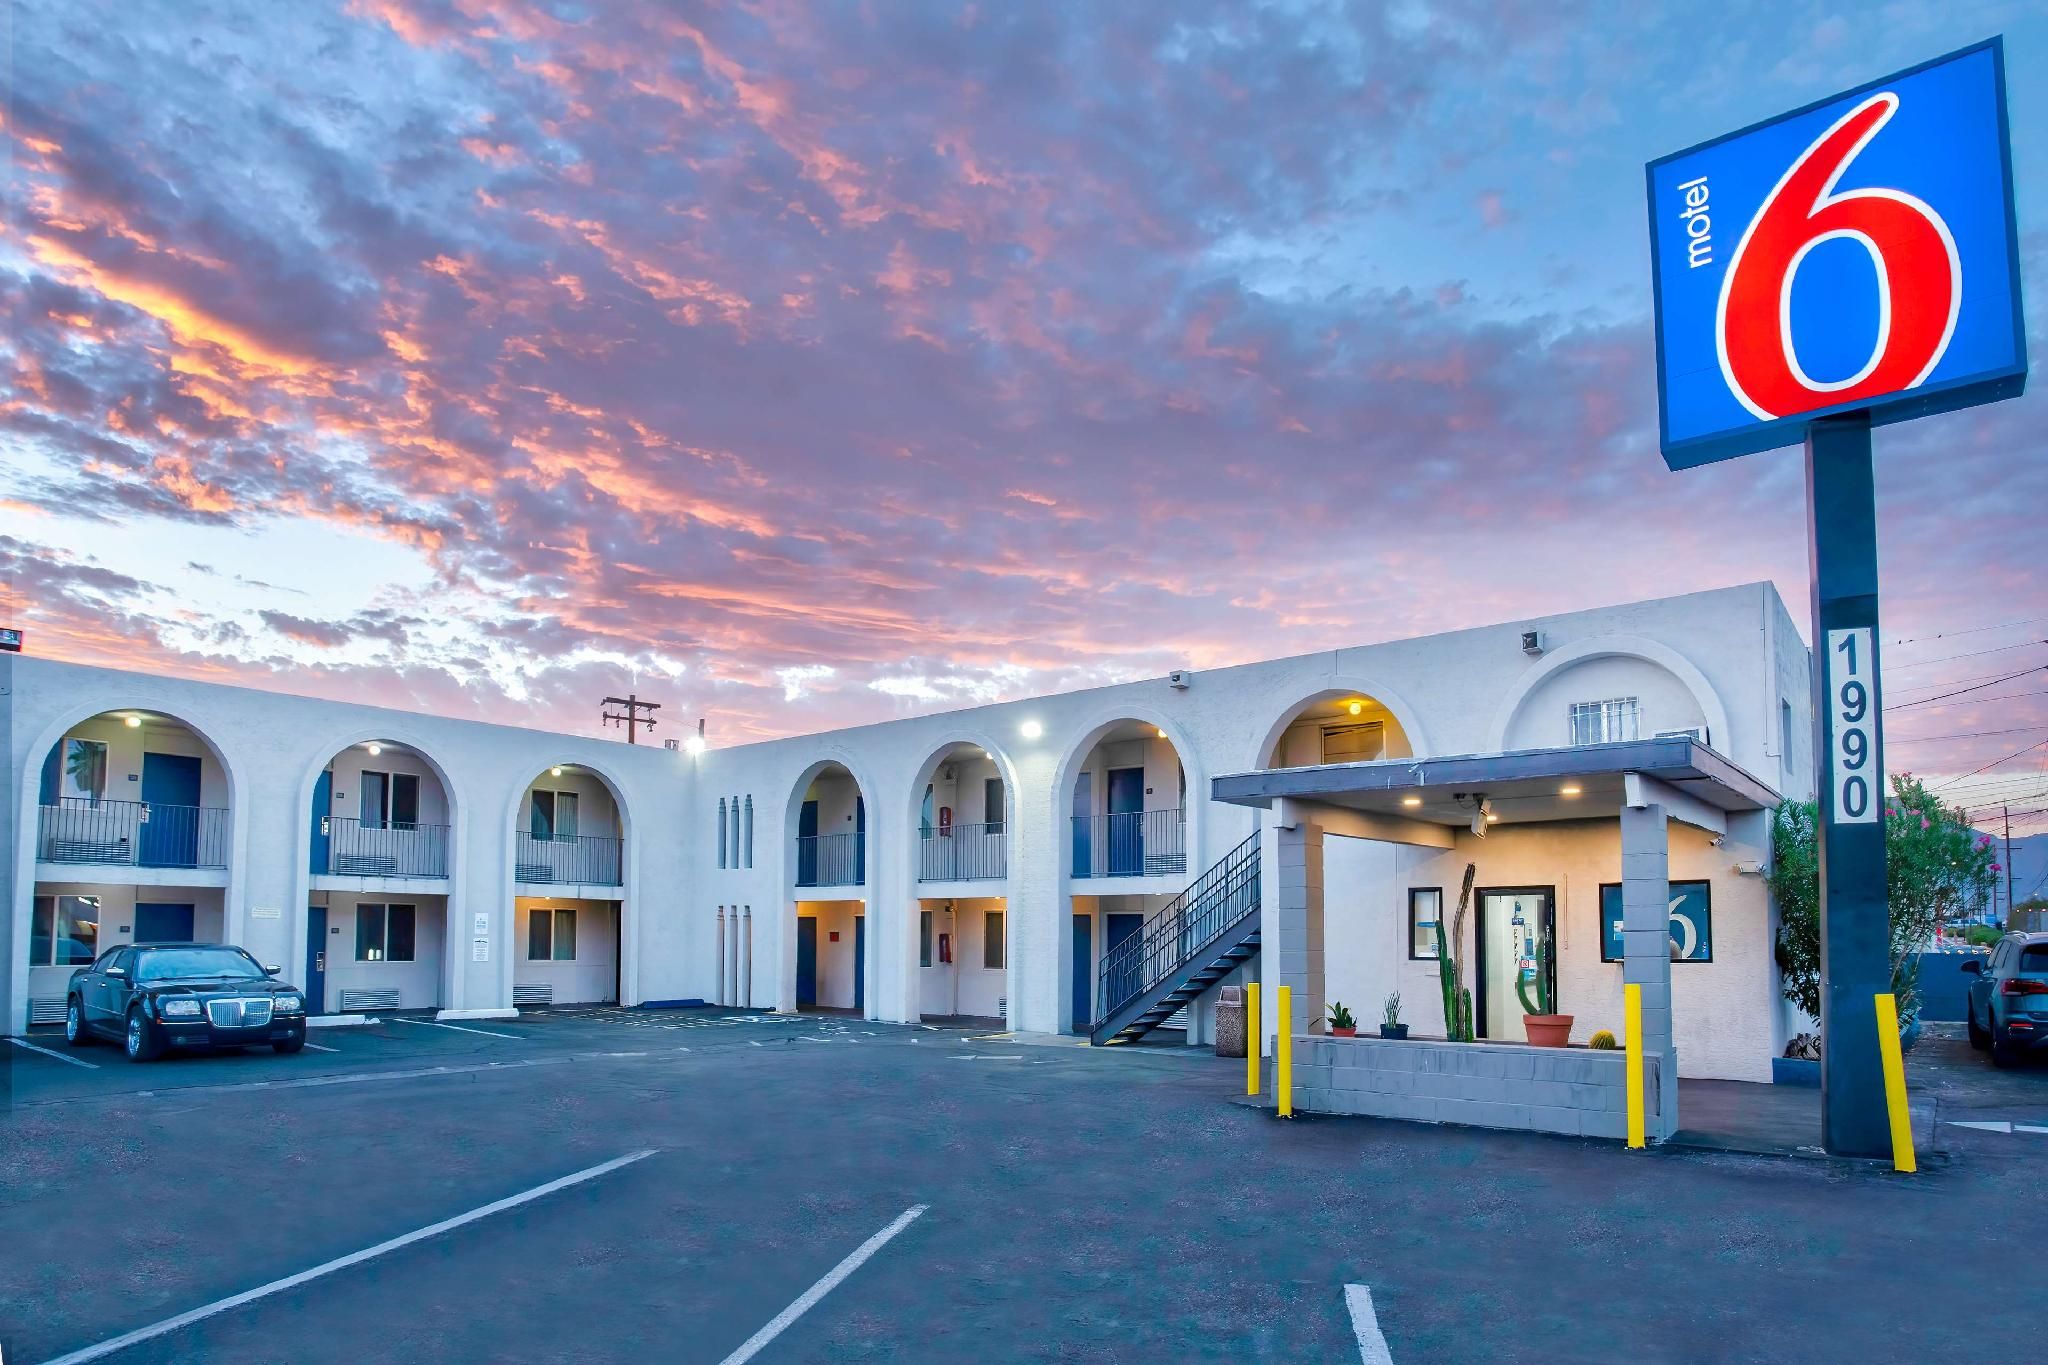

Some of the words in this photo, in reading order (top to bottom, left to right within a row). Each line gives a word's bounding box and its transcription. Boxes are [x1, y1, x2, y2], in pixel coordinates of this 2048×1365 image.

[1677, 176, 1713, 269] motel
[1715, 91, 1963, 421] 6
[1838, 633, 1868, 818] 1990
